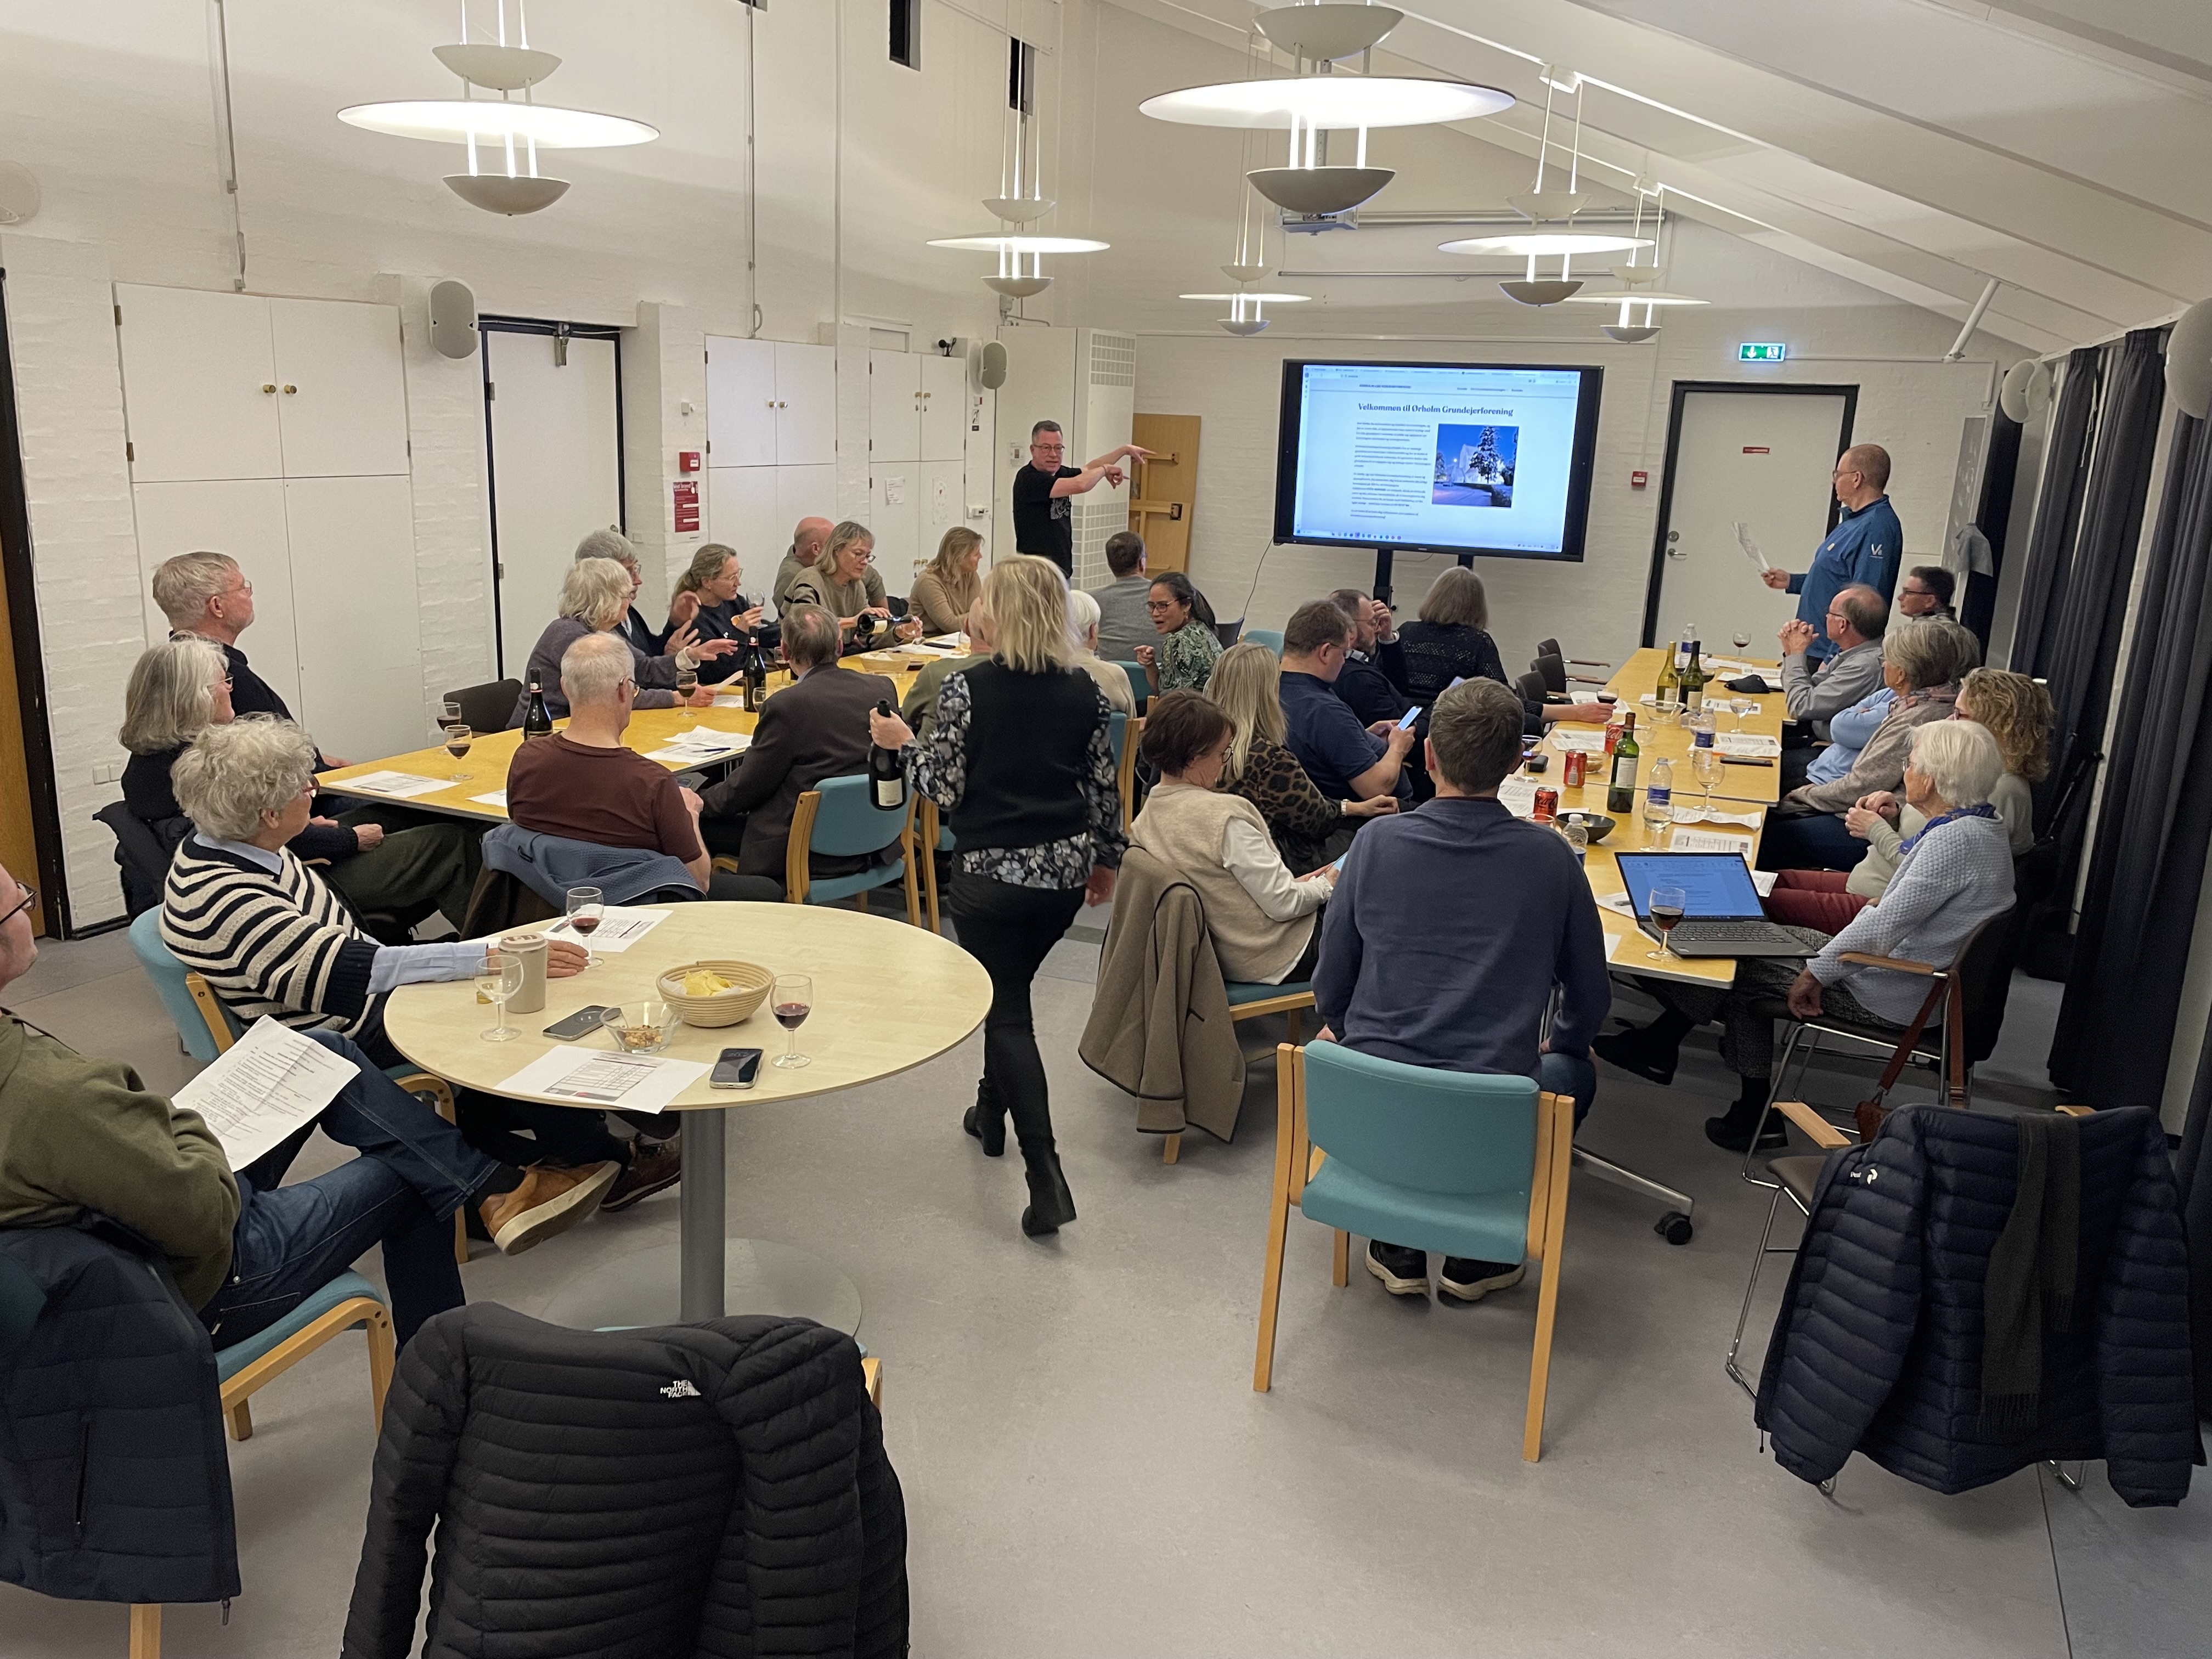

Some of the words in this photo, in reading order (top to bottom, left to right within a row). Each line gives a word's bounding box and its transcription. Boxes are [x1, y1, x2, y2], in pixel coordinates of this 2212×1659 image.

[1358, 403, 1402, 412] Velkommen
[1442, 405, 1514, 417] Grundejerforening
[673, 1380, 687, 1388] THE
